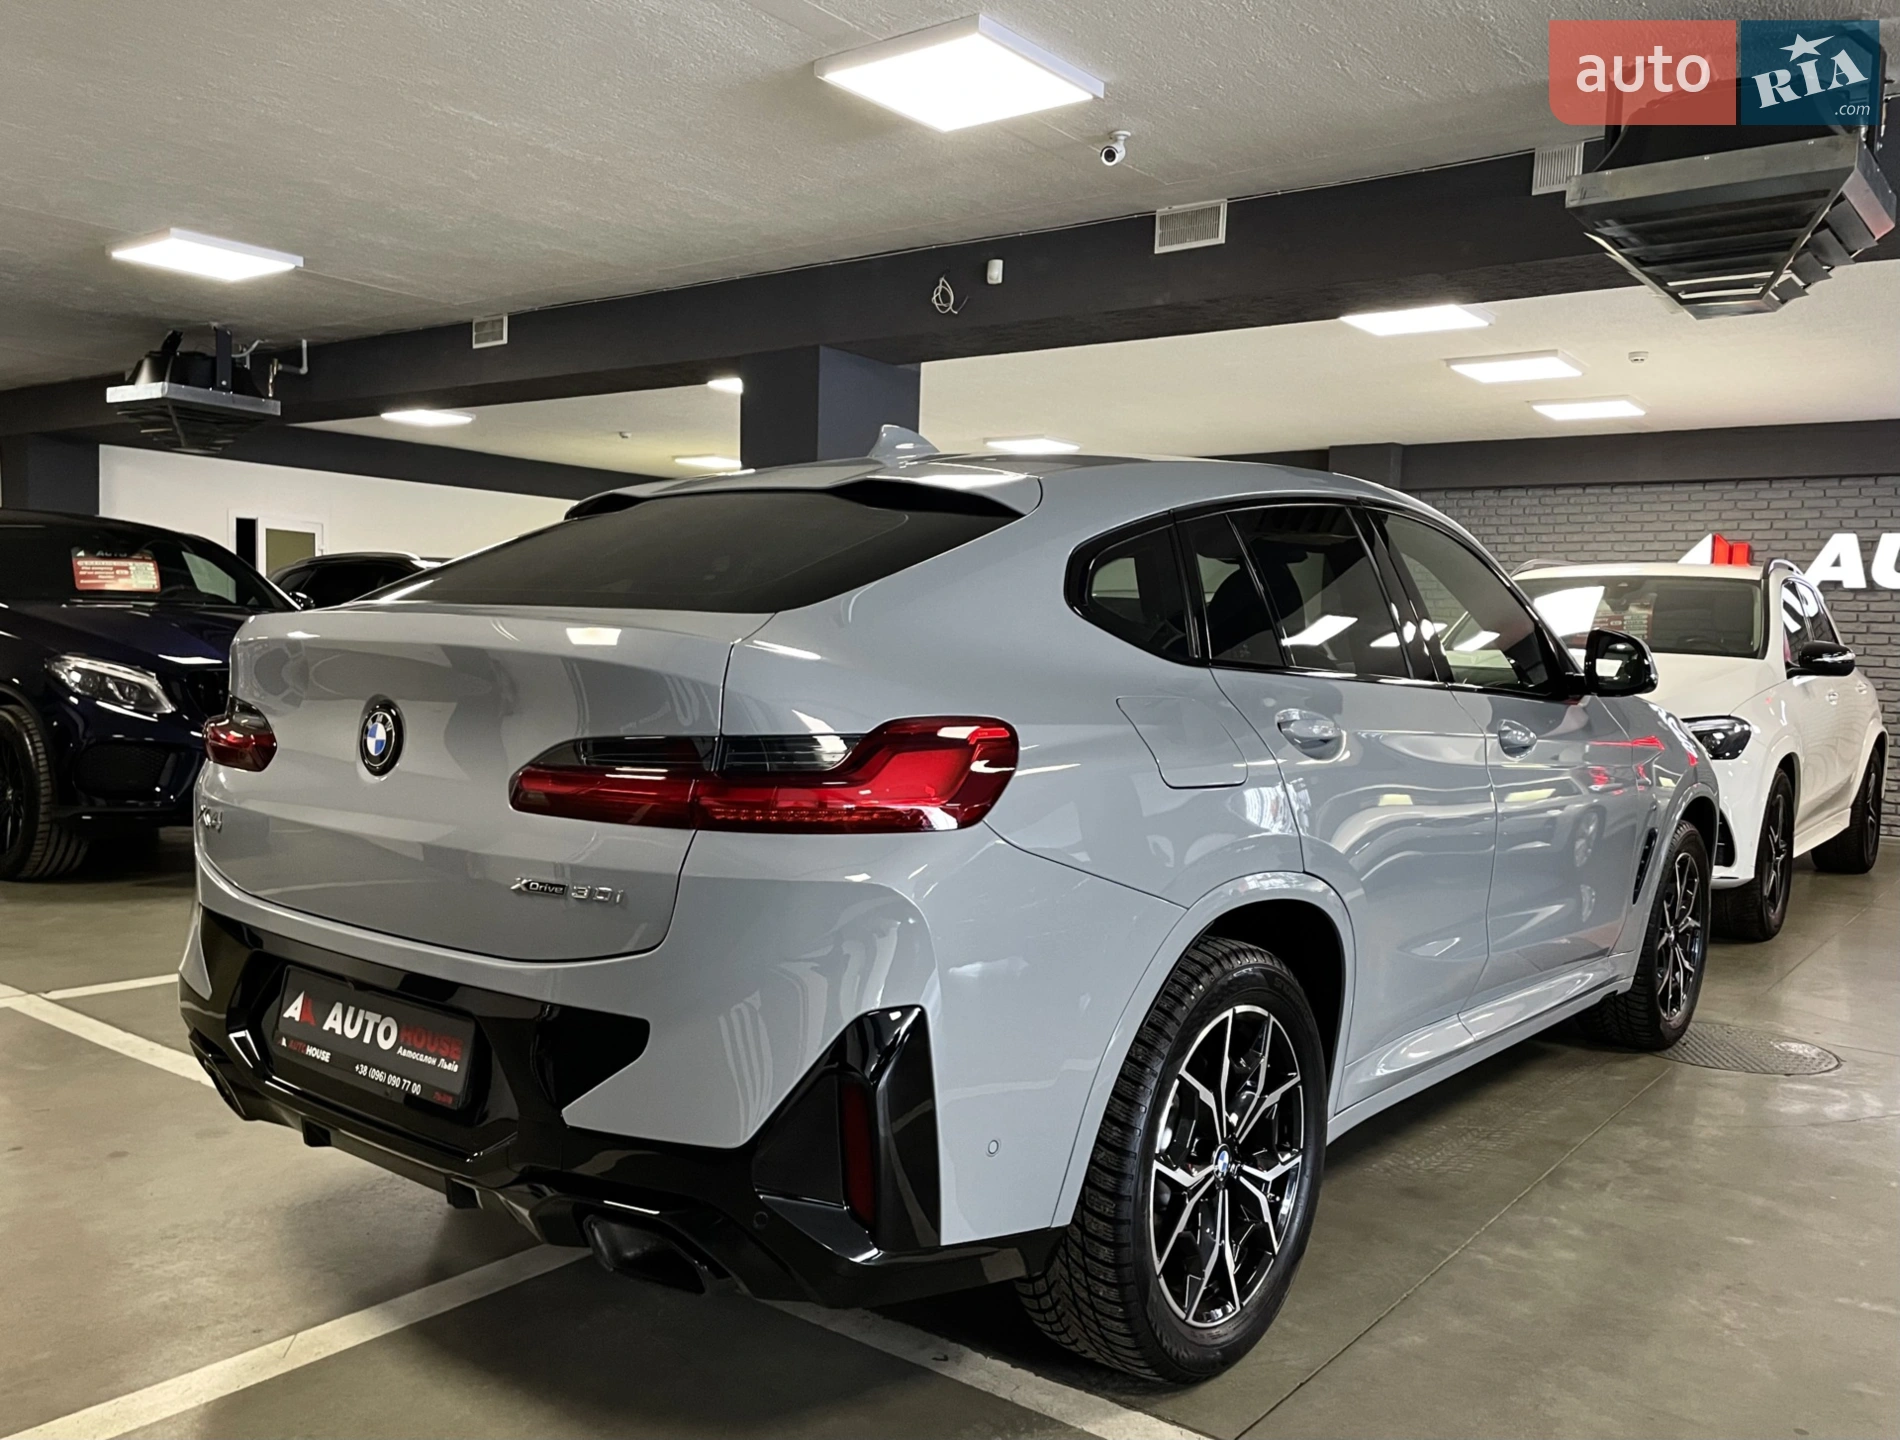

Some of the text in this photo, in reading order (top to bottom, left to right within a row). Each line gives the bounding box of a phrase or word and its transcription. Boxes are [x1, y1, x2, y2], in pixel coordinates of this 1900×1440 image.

[322, 1001, 398, 1050] AUTO
[387, 1074, 401, 1088] 090
[401, 1079, 412, 1091] 77
[411, 1083, 422, 1096] 00
